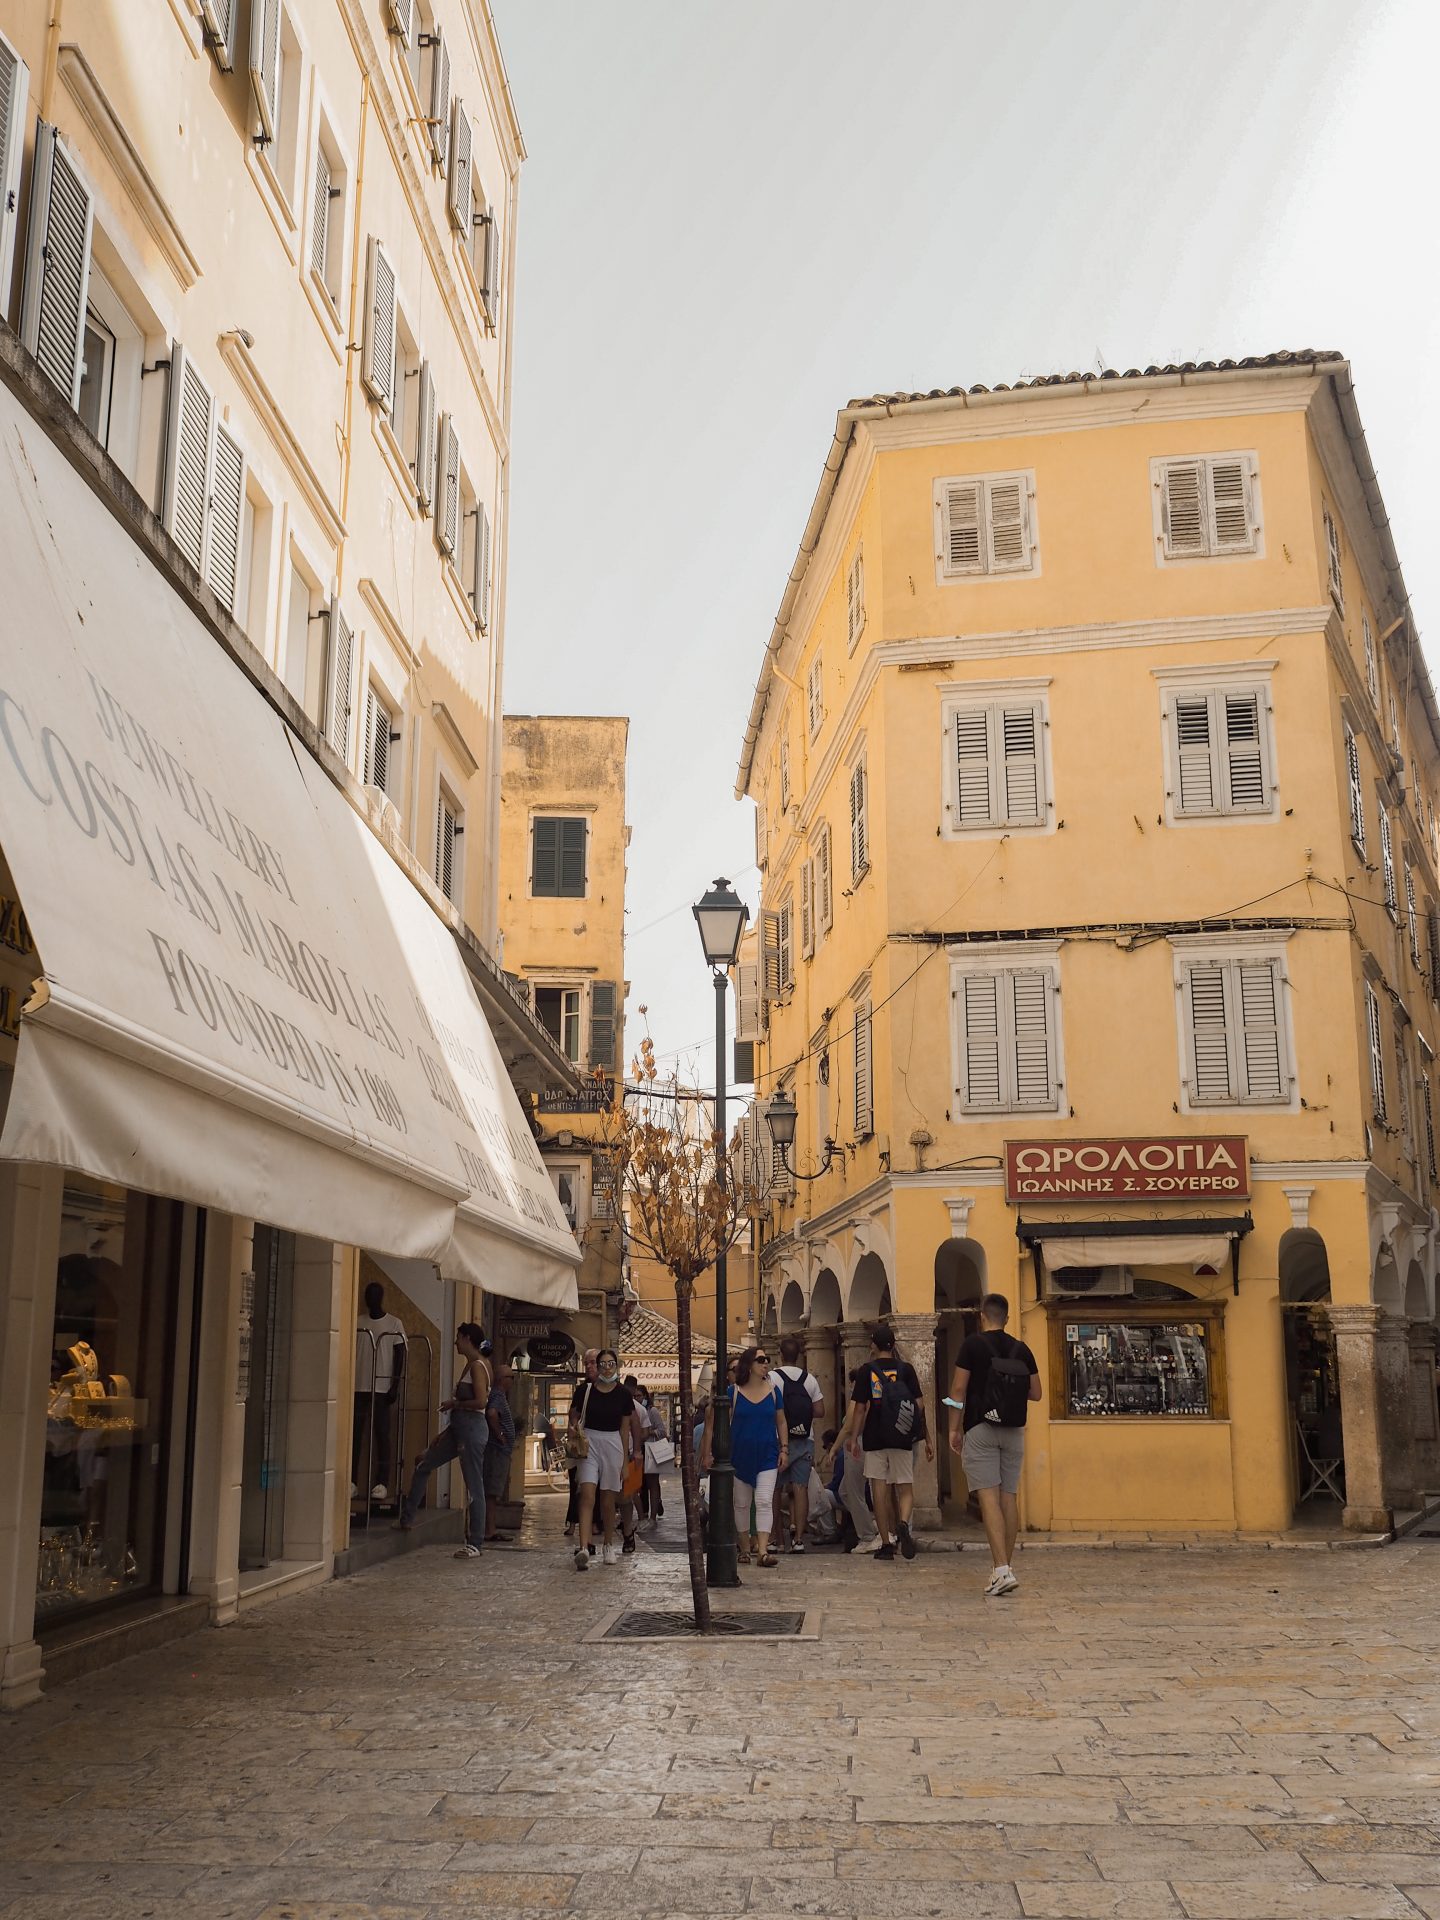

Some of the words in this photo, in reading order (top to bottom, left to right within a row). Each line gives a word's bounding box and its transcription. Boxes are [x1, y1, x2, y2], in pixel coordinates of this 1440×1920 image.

[83, 666, 298, 905] JEWELLERY
[0, 687, 221, 935] COSTAS
[211, 871, 406, 1060] MAROLLAS
[147, 929, 326, 1091] FOUNDED
[354, 1063, 408, 1134] 1889
[1015, 1143, 1238, 1173] ΩΡΟΛΟΓΙΑ
[1017, 1178, 1115, 1193] ΙΩΑΝΝΗΣ
[1122, 1177, 1141, 1192] Σ.
[1144, 1175, 1240, 1191] ΣΟΥΕΡΕΦ
[637, 1372, 680, 1380] CORNE
[895, 1399, 915, 1435] NIKE
